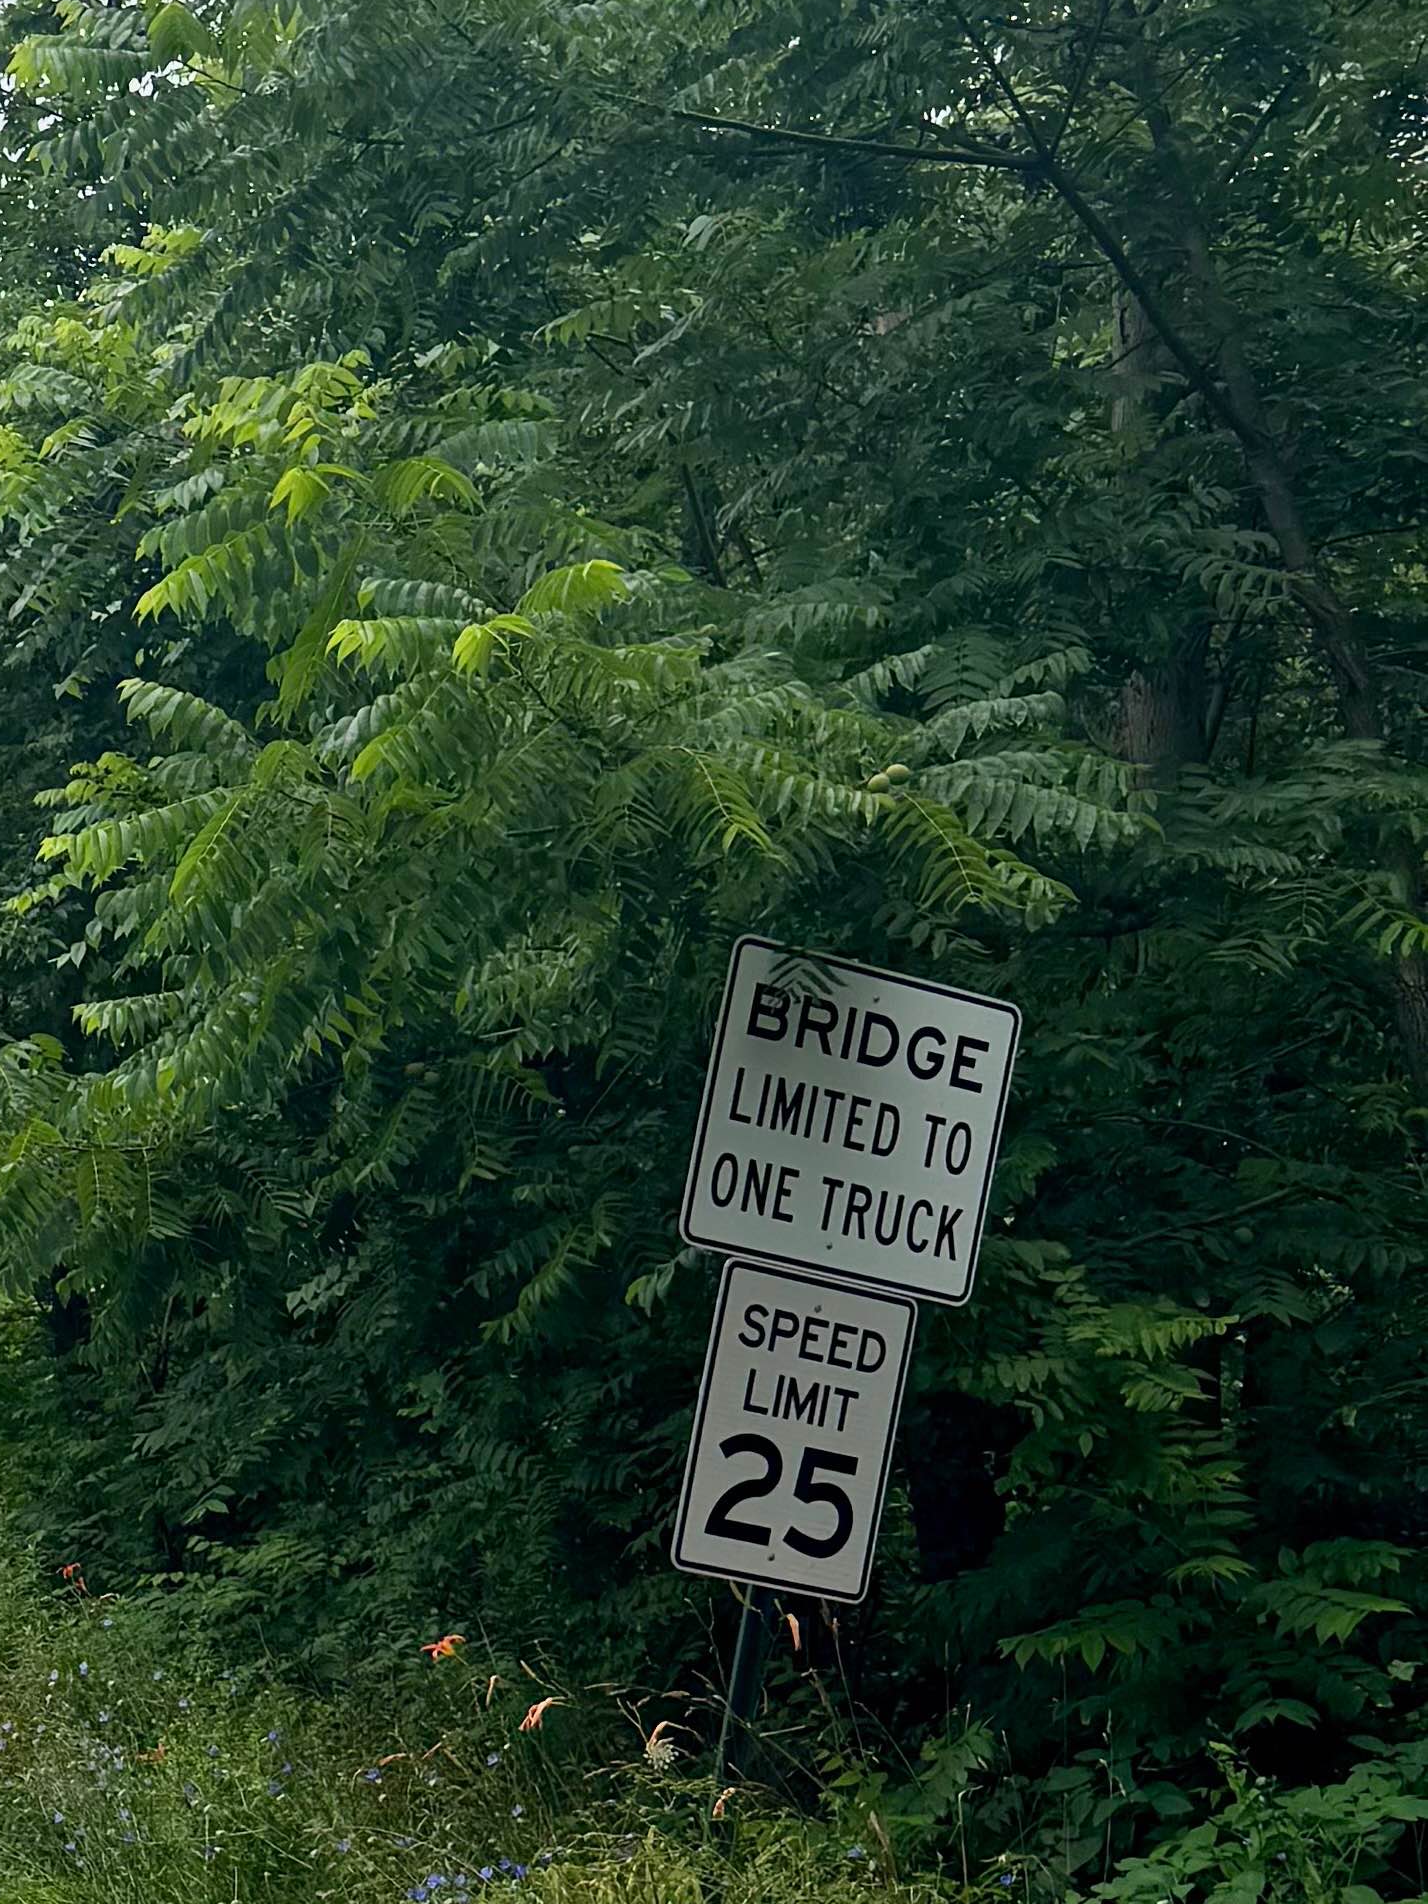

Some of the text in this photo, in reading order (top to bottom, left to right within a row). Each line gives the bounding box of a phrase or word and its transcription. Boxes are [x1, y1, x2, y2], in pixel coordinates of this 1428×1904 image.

[746, 982, 989, 1093] BRIDGE
[729, 1067, 972, 1176] LIMITED TO
[710, 1152, 964, 1261] ONE TRUCK
[738, 1304, 887, 1374] SPEED
[743, 1368, 860, 1432] LIMIT
[704, 1433, 859, 1559] 25
